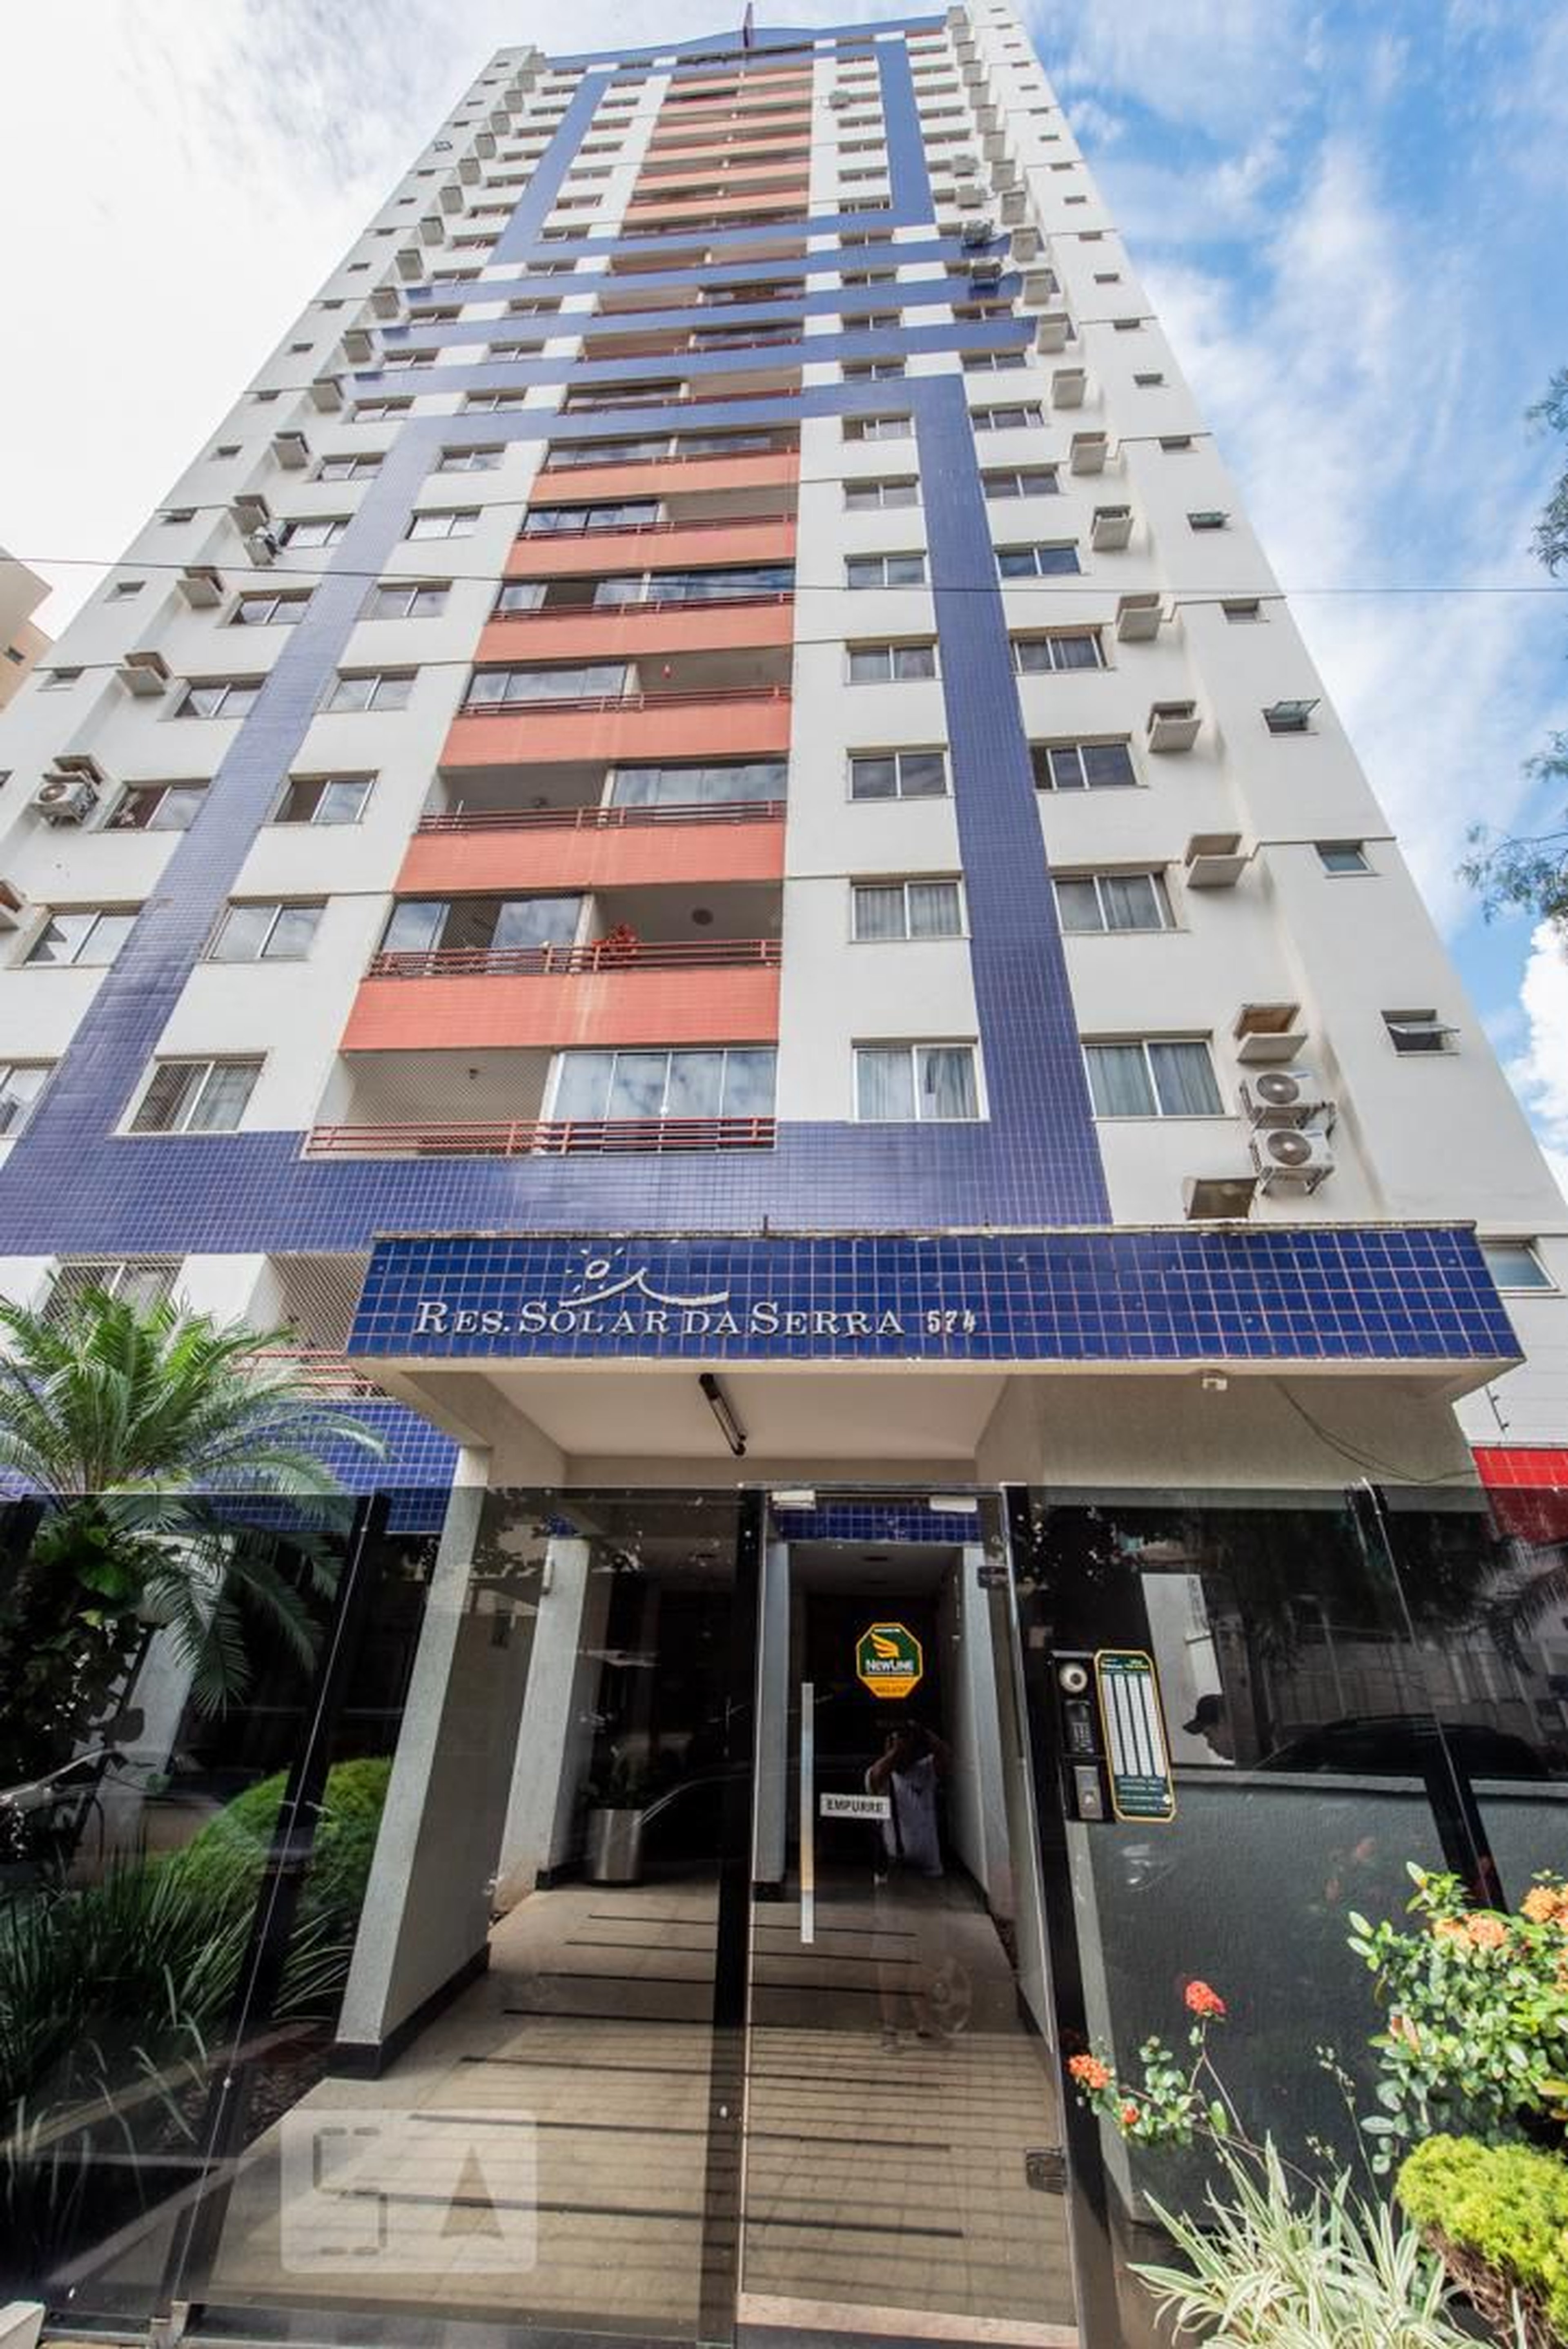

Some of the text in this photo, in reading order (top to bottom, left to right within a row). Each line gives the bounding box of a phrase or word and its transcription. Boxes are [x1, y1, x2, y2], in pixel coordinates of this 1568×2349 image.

[414, 1301, 976, 1335] RES. SOLAR DA SERRA 574
[827, 1799, 884, 1814] EMPURRE
